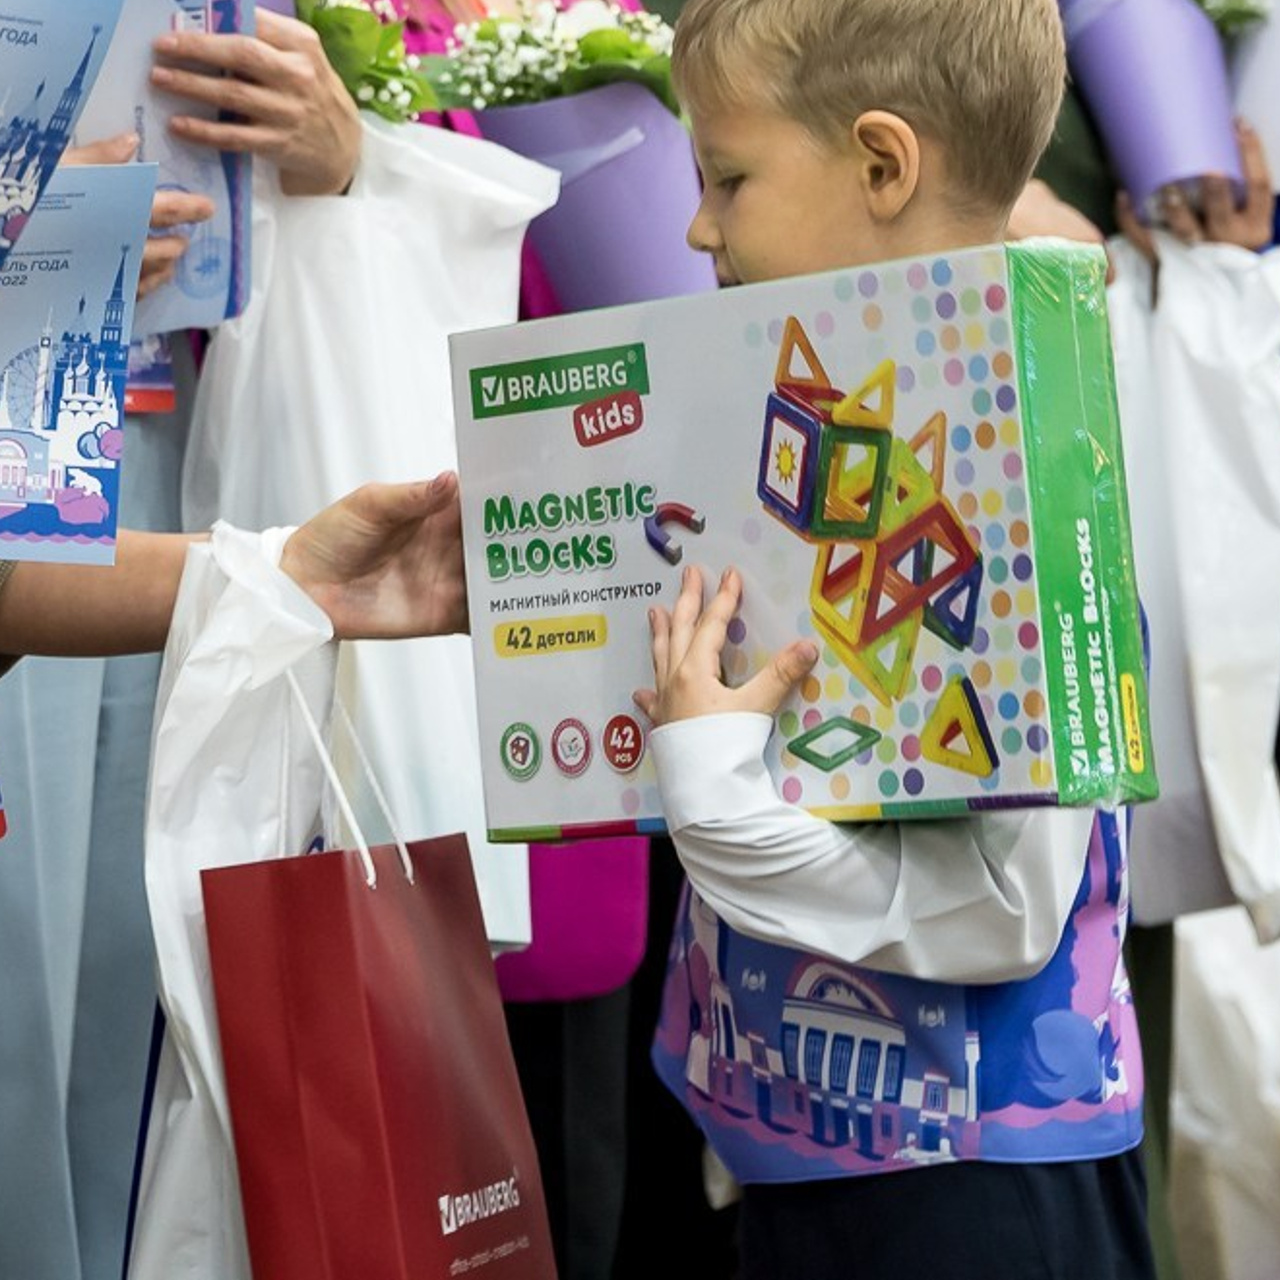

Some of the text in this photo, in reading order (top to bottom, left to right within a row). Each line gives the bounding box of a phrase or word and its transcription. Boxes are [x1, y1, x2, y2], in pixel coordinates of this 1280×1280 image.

[31, 260, 69, 272] ГОДА
[507, 360, 627, 402] BRAUBERG
[580, 401, 635, 439] kids
[483, 482, 656, 535] MAGNETIC
[485, 533, 615, 579] BLOCKS
[1076, 518, 1100, 624] BLOCKS
[489, 582, 662, 612] МАГНИТНЫЙ КОНСТРУКТОР
[506, 626, 596, 650] 42 детали
[1059, 613, 1087, 747] BRAUBERG
[609, 725, 635, 749] 42
[455, 1176, 520, 1228] BRAUBERG
